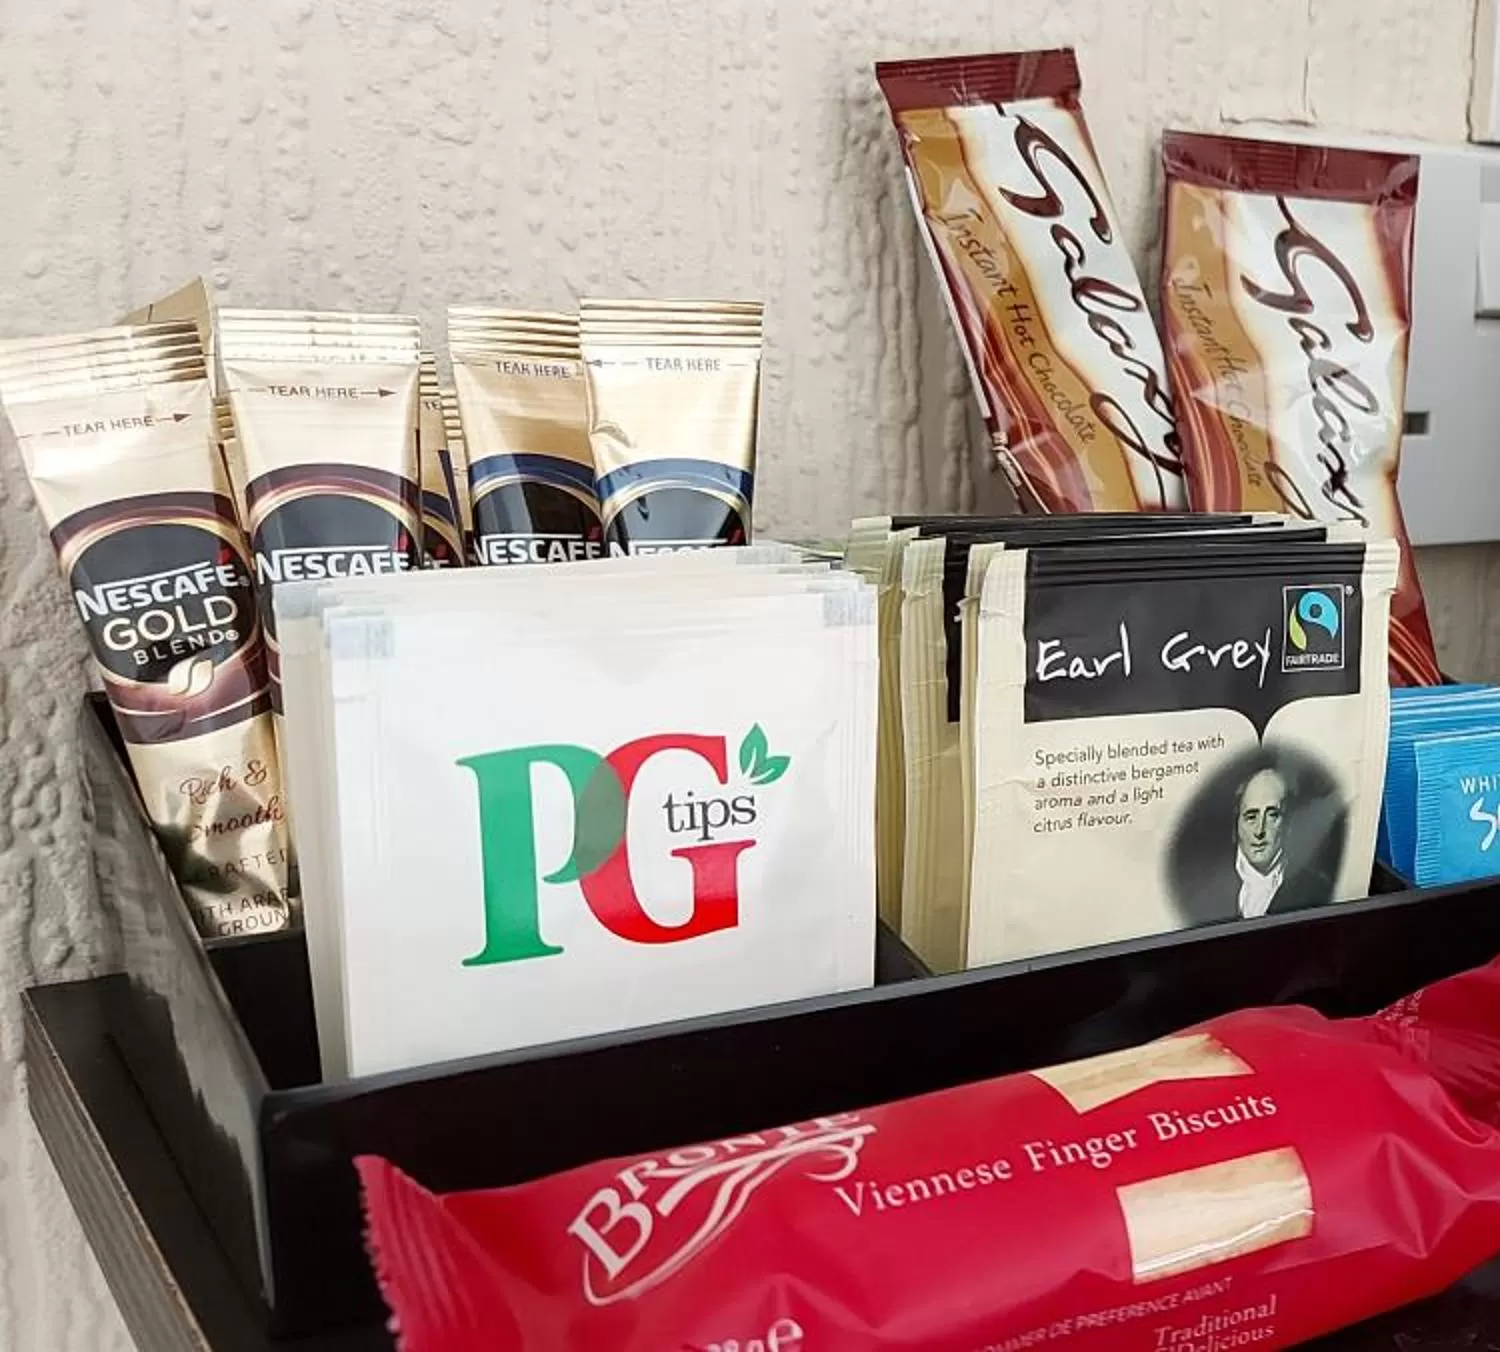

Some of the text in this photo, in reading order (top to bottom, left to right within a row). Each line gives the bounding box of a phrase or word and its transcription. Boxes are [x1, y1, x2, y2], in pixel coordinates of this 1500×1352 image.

[935, 207, 1097, 443] Instant Hot Chocolate
[994, 101, 1183, 511] Galaxy
[1171, 281, 1233, 357] Instant
[494, 360, 571, 379] TEAR HERE
[645, 357, 722, 373] TEAR HERE
[1241, 194, 1379, 529] Galaxy
[270, 385, 360, 399] TEAR HERE
[63, 414, 156, 438] TEAR HERE
[103, 595, 239, 651] GOLD
[1036, 620, 1272, 689] Earl Grey
[1285, 653, 1341, 667] FAIRTRADE
[1034, 733, 1225, 770] Specially blended tea with
[1036, 761, 1200, 789] a distinctive bergamot
[179, 759, 268, 805] Rich &
[1034, 785, 1164, 811] aroma and a light
[661, 790, 758, 842] tips
[1033, 811, 1133, 833] citrus flavour.
[454, 732, 757, 967] PG
[833, 1094, 1278, 1218] Viennese Finger Biscuits
[1153, 1293, 1278, 1347] Traditional
